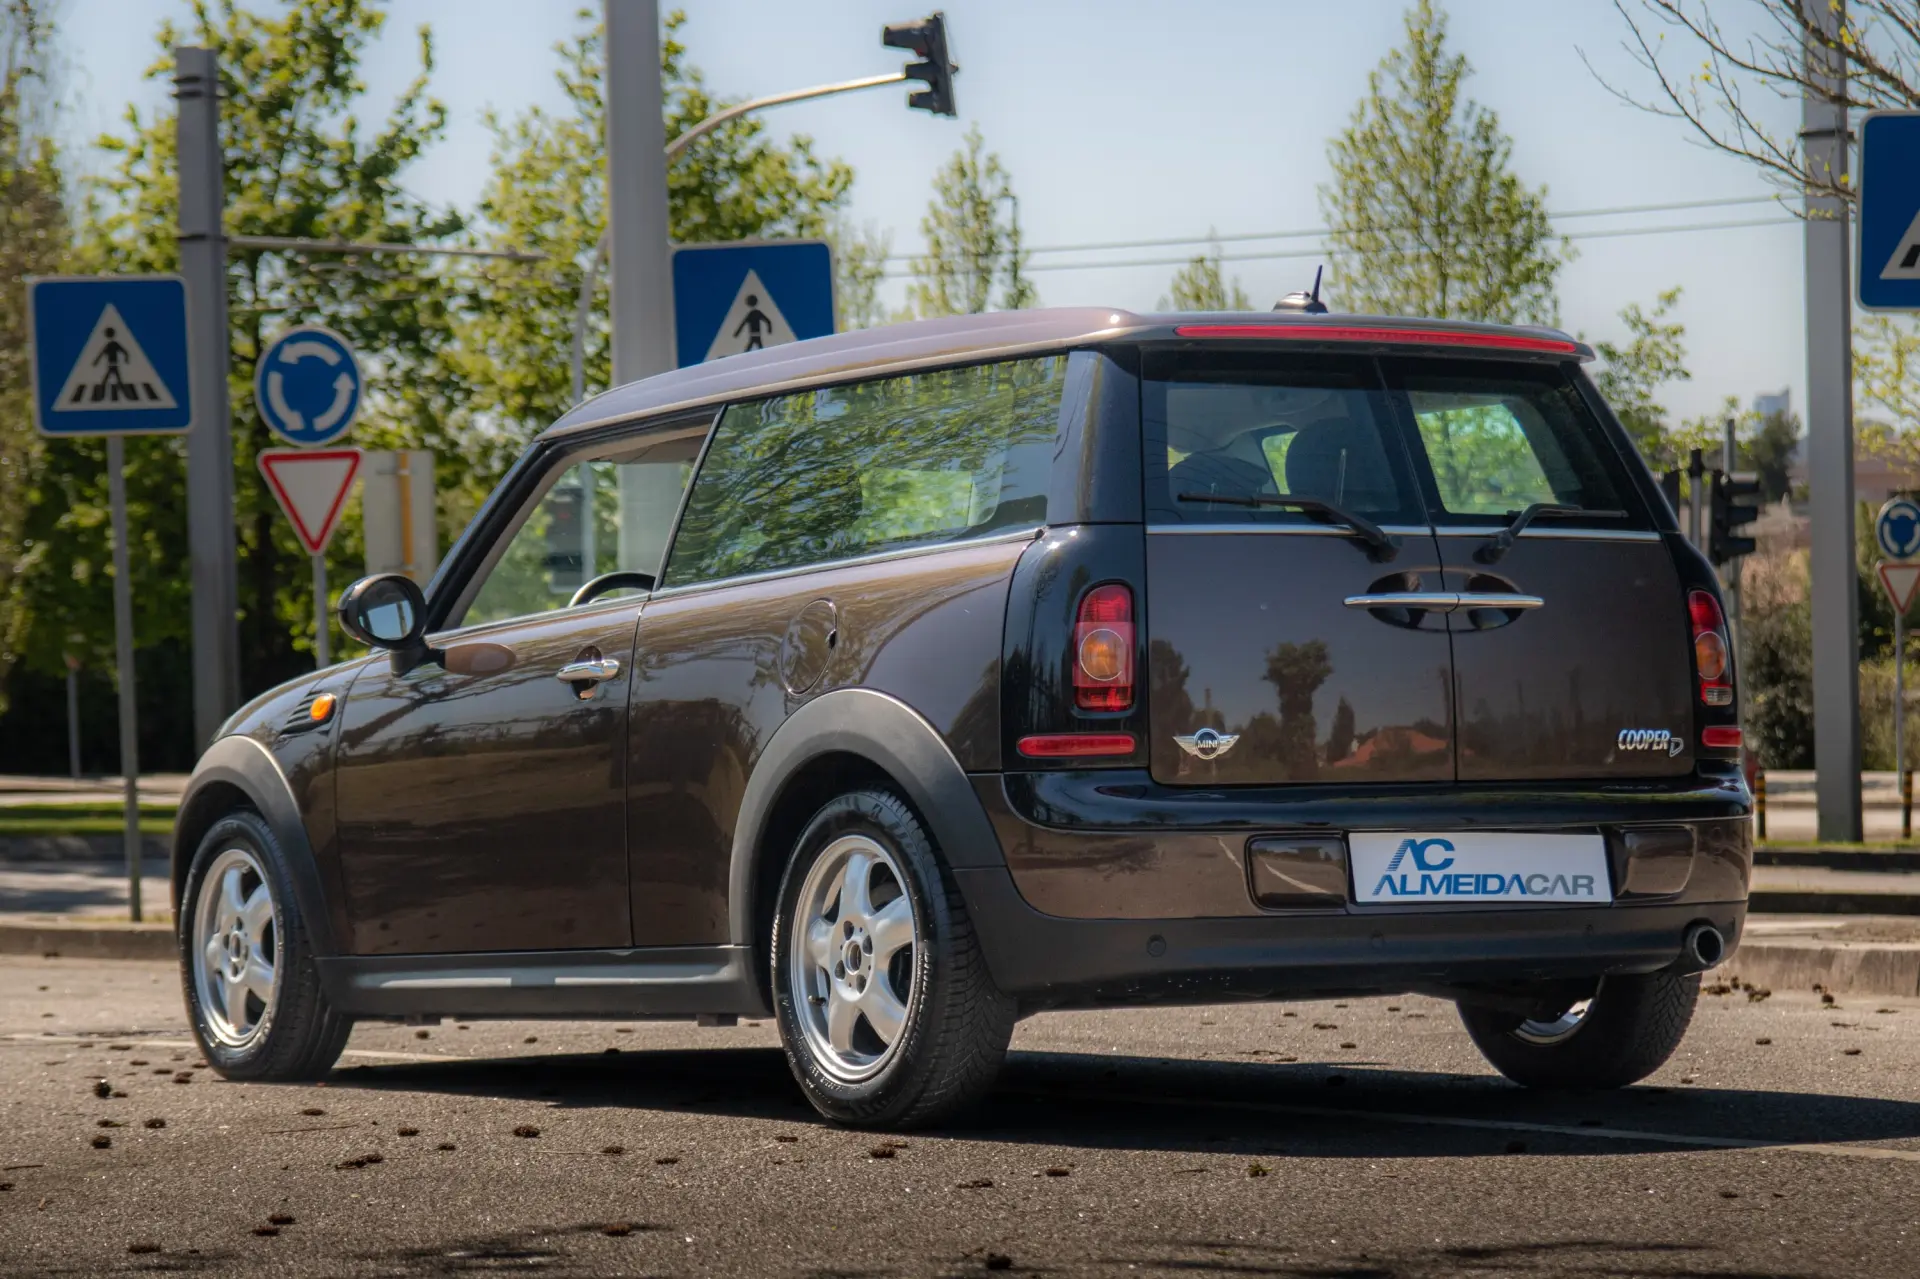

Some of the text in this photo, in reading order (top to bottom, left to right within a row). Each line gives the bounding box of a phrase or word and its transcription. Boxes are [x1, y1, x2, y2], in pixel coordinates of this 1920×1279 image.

[1197, 739, 1218, 749] MINI
[1618, 729, 1684, 758] COOPER D
[1386, 838, 1455, 871] AC
[1372, 873, 1595, 896] ALMEIDACAR
